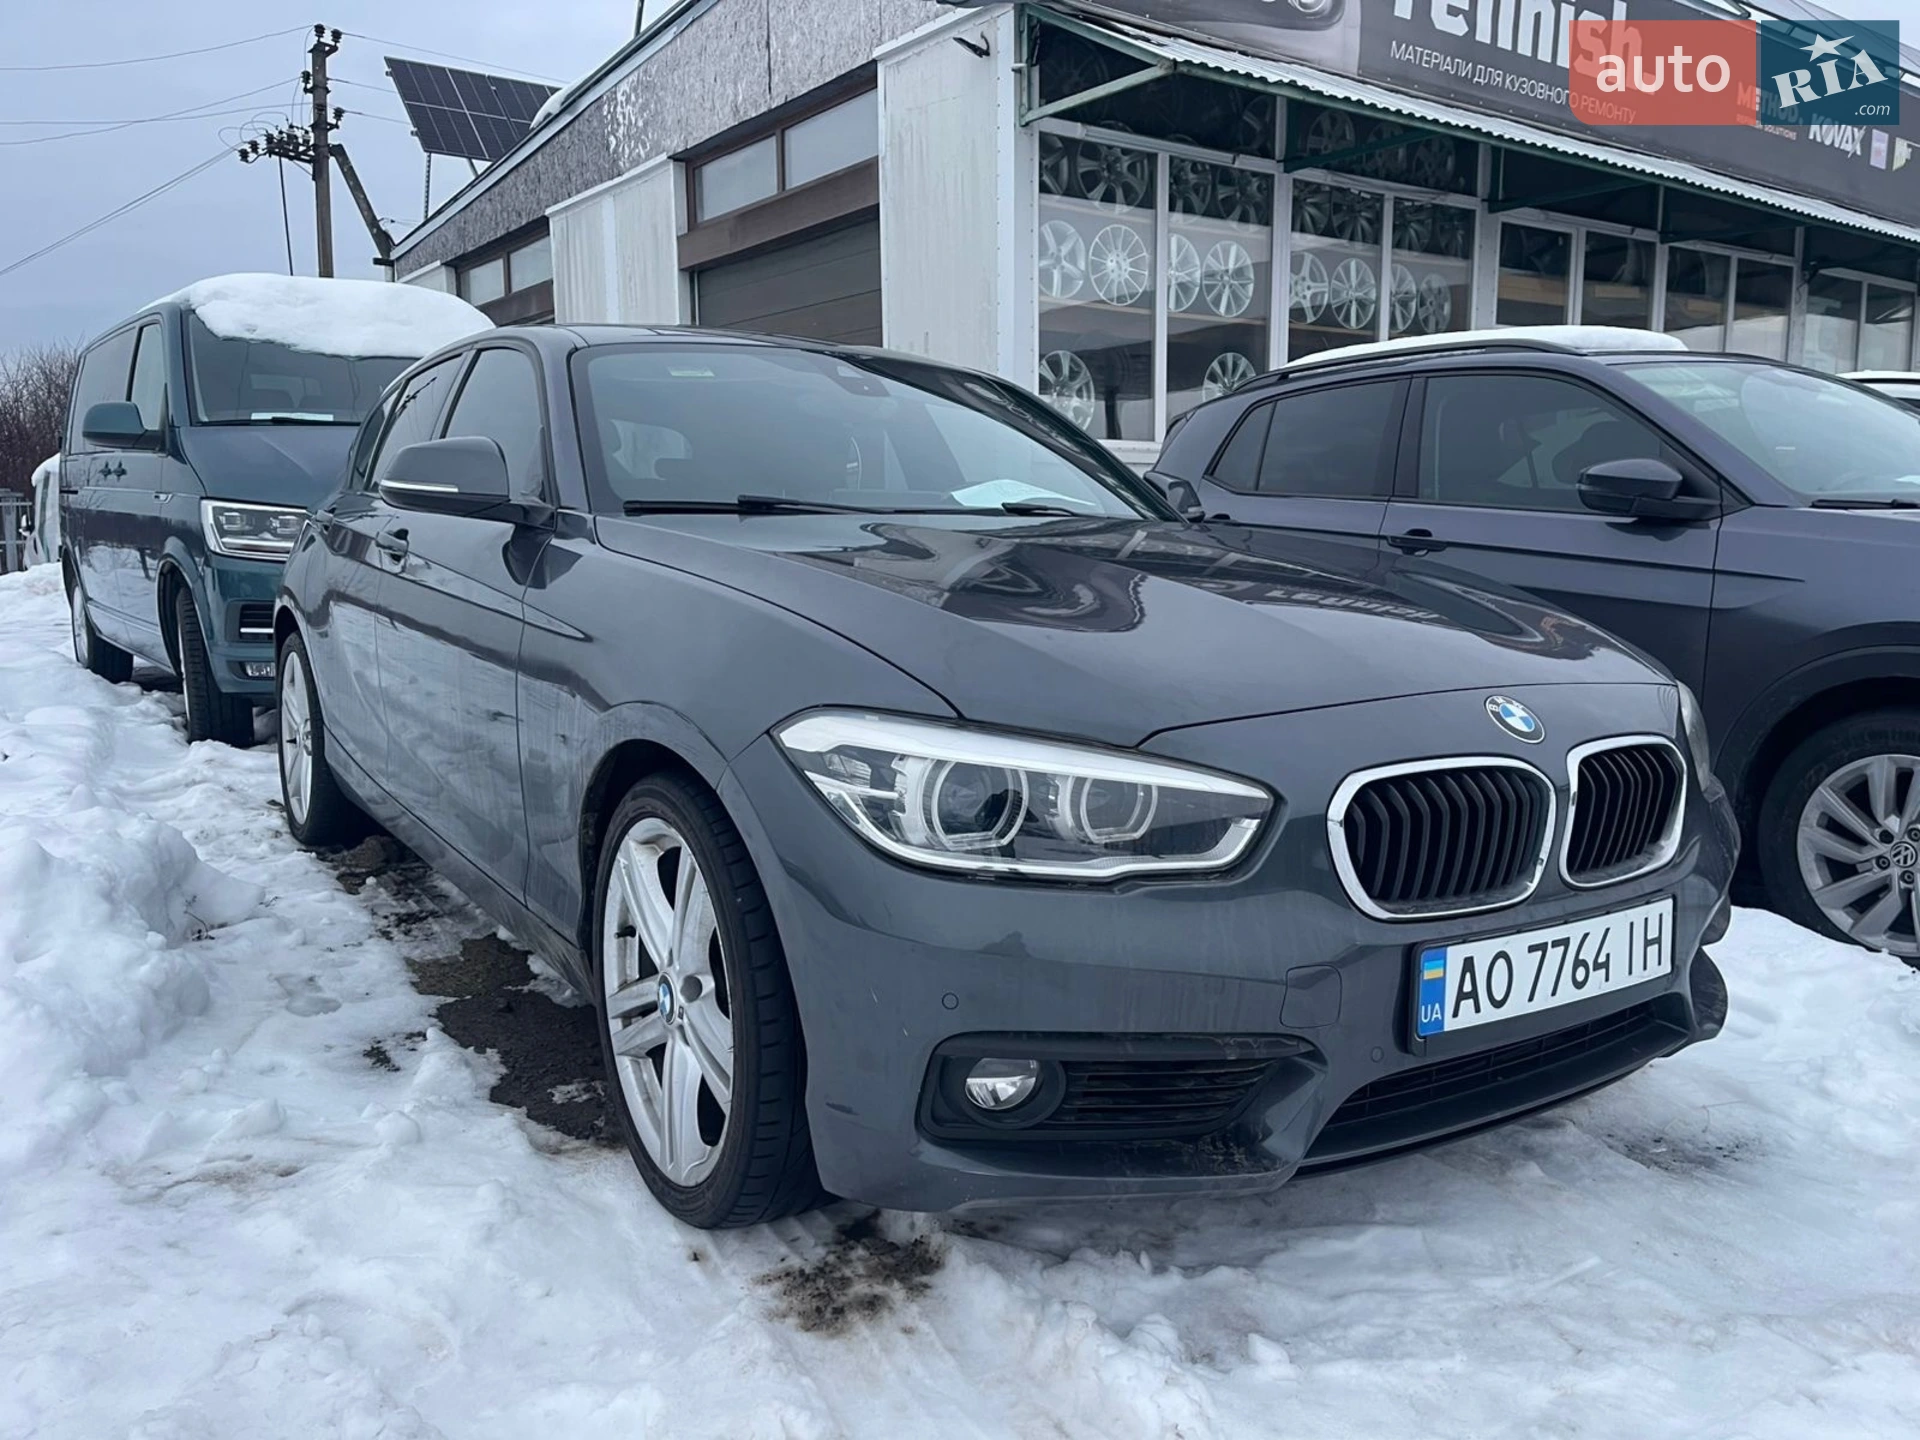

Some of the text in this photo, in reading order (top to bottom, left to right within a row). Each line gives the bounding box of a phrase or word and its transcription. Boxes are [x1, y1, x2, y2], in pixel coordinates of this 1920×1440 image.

[1390, 40, 1636, 124] МАТЕРІАЛИ ДЛЯ КУЗОВНОГО РЕМОНТУ
[1809, 113, 1867, 158] KOVAX
[1452, 913, 1663, 1018] AO 7764 IH
[1421, 1002, 1442, 1023] UA
